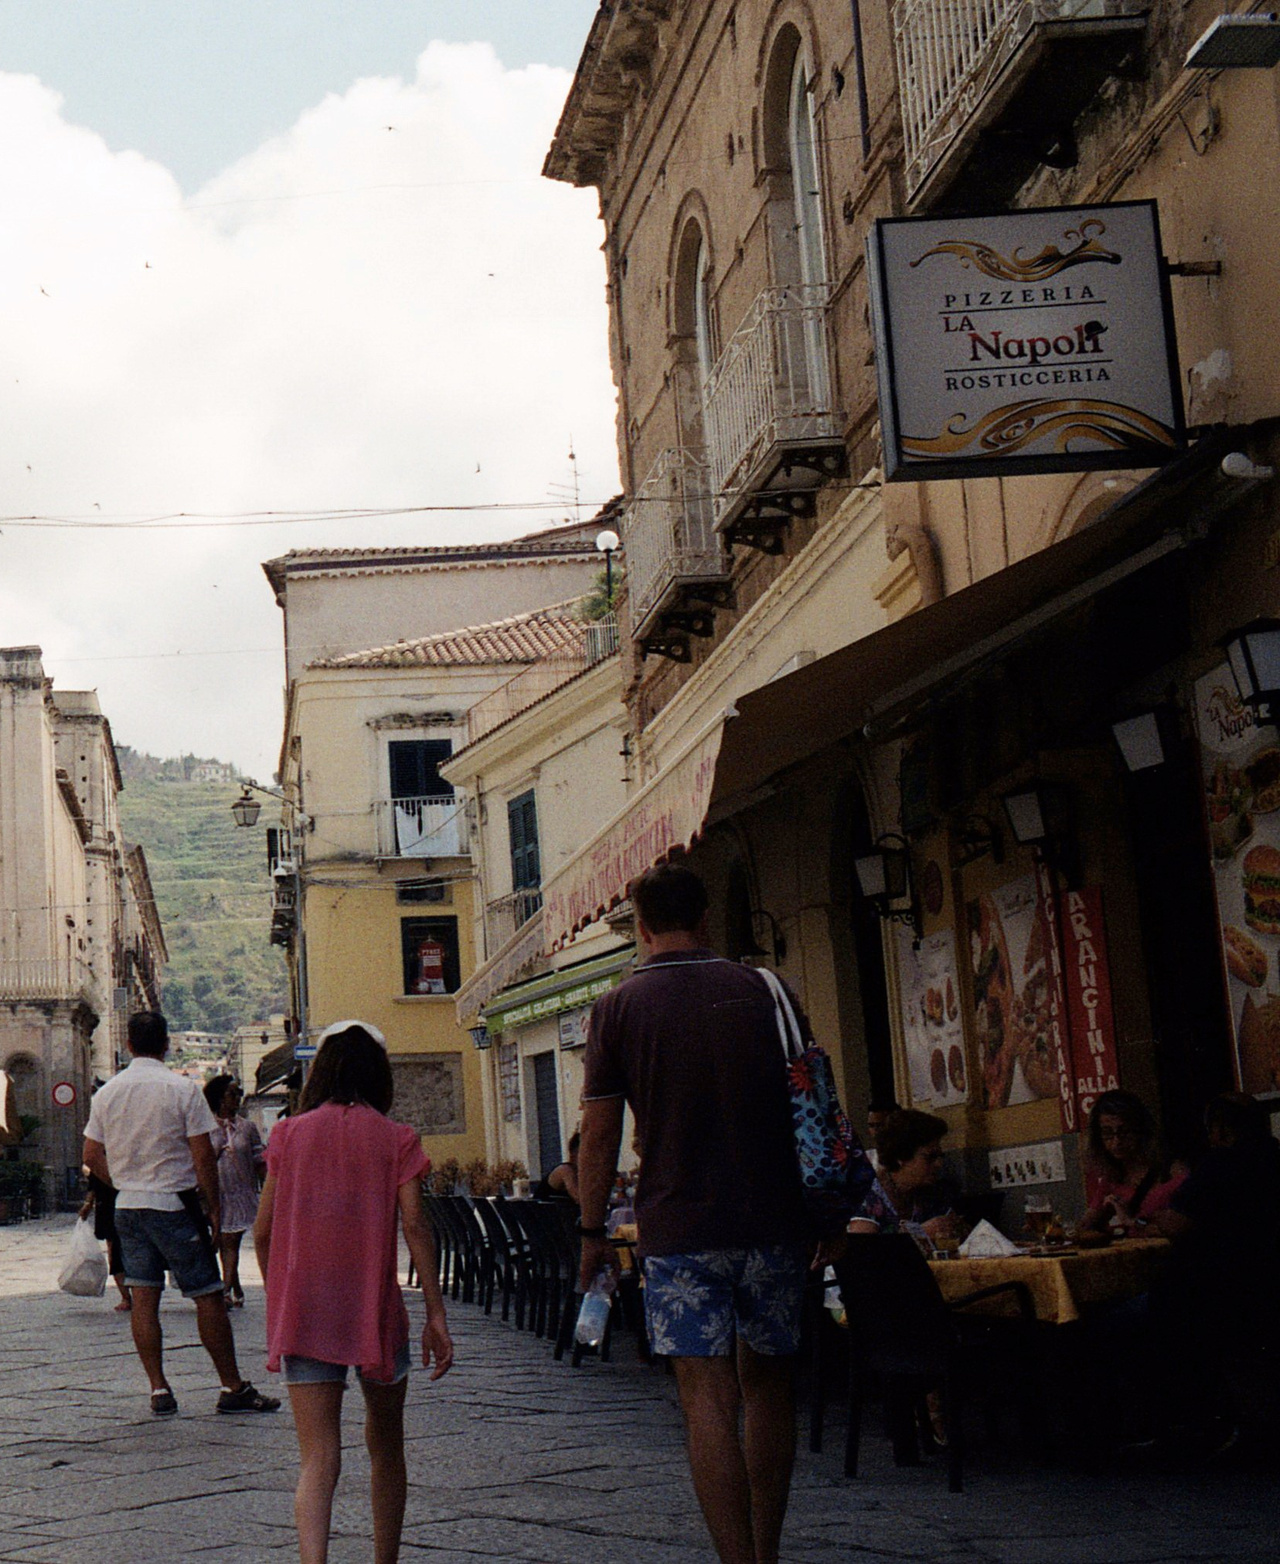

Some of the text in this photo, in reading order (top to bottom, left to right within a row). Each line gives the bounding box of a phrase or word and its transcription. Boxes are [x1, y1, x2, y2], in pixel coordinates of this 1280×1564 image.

[944, 285, 1095, 308] PIZZERIA
[944, 315, 975, 333] LA
[969, 323, 1105, 365] Napoli
[945, 367, 1111, 391] ROSTICCERIA
[1068, 891, 1106, 1077] ARANCINI
[1077, 1075, 1120, 1094] ALLA
